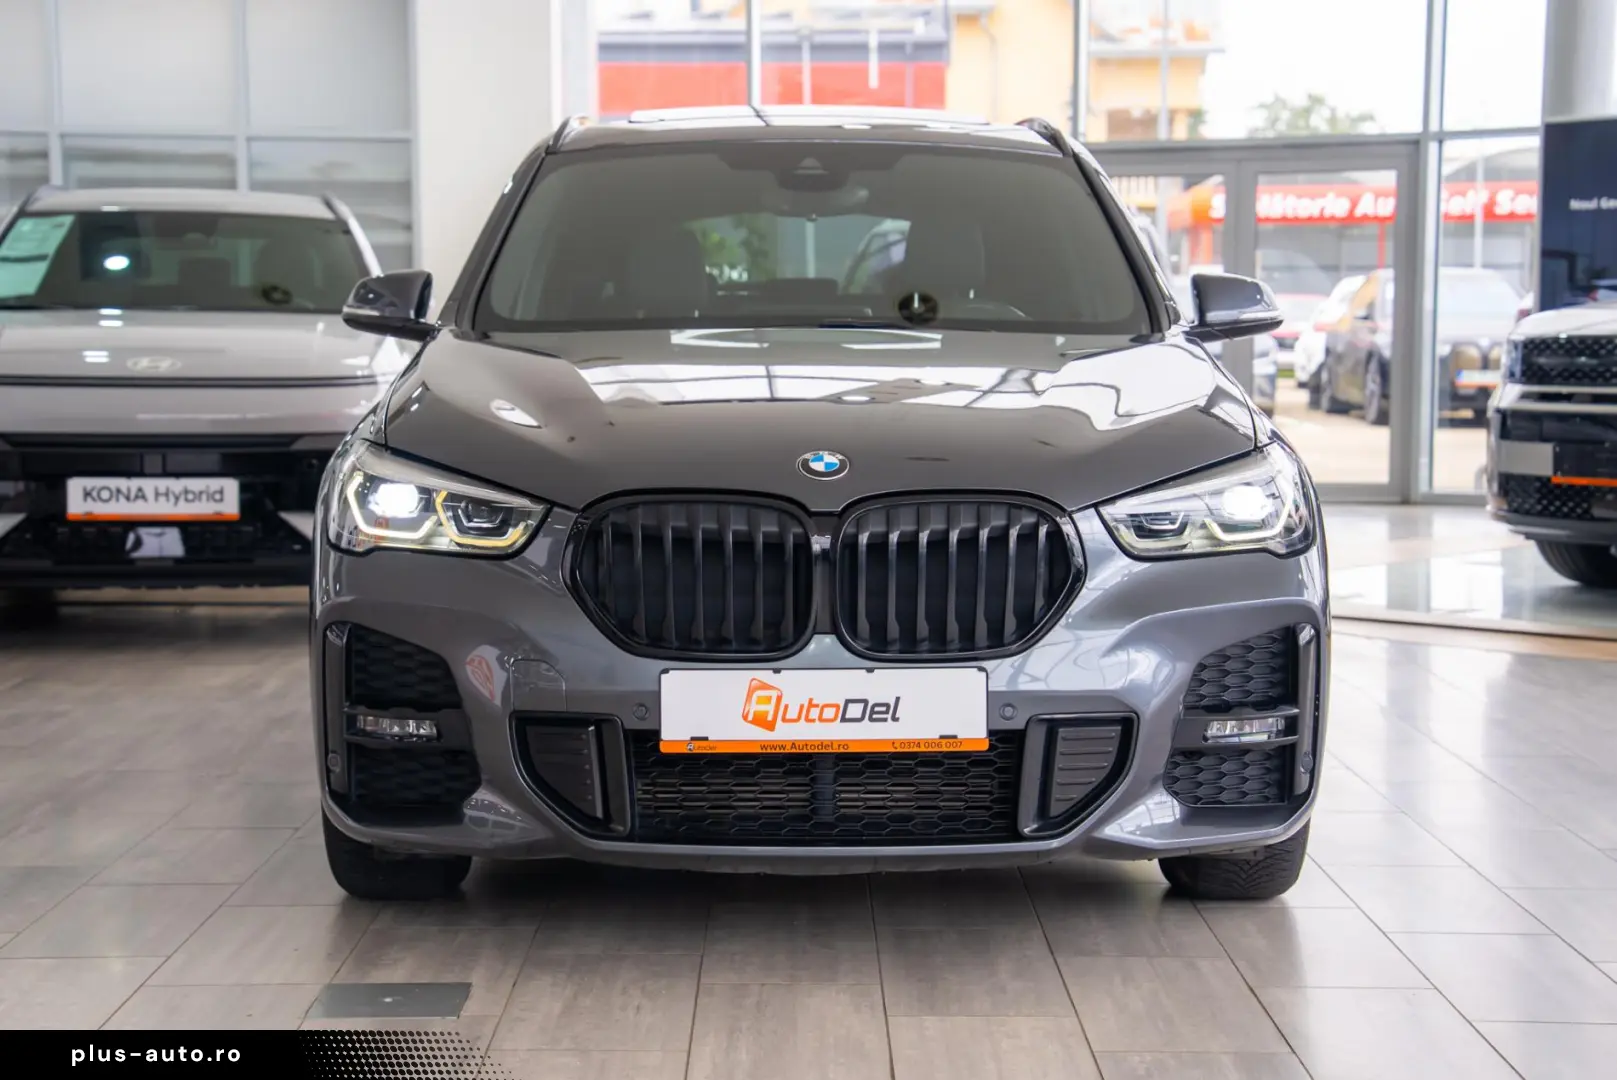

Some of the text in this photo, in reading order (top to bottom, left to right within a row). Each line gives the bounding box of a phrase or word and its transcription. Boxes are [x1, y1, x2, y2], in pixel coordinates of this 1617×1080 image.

[1354, 192, 1396, 218] Au
[83, 484, 225, 507] KONA Hybrid
[745, 687, 901, 725] AutoDel
[759, 741, 850, 752] www.Autodel.ro
[899, 740, 963, 750] 0374 006 007
